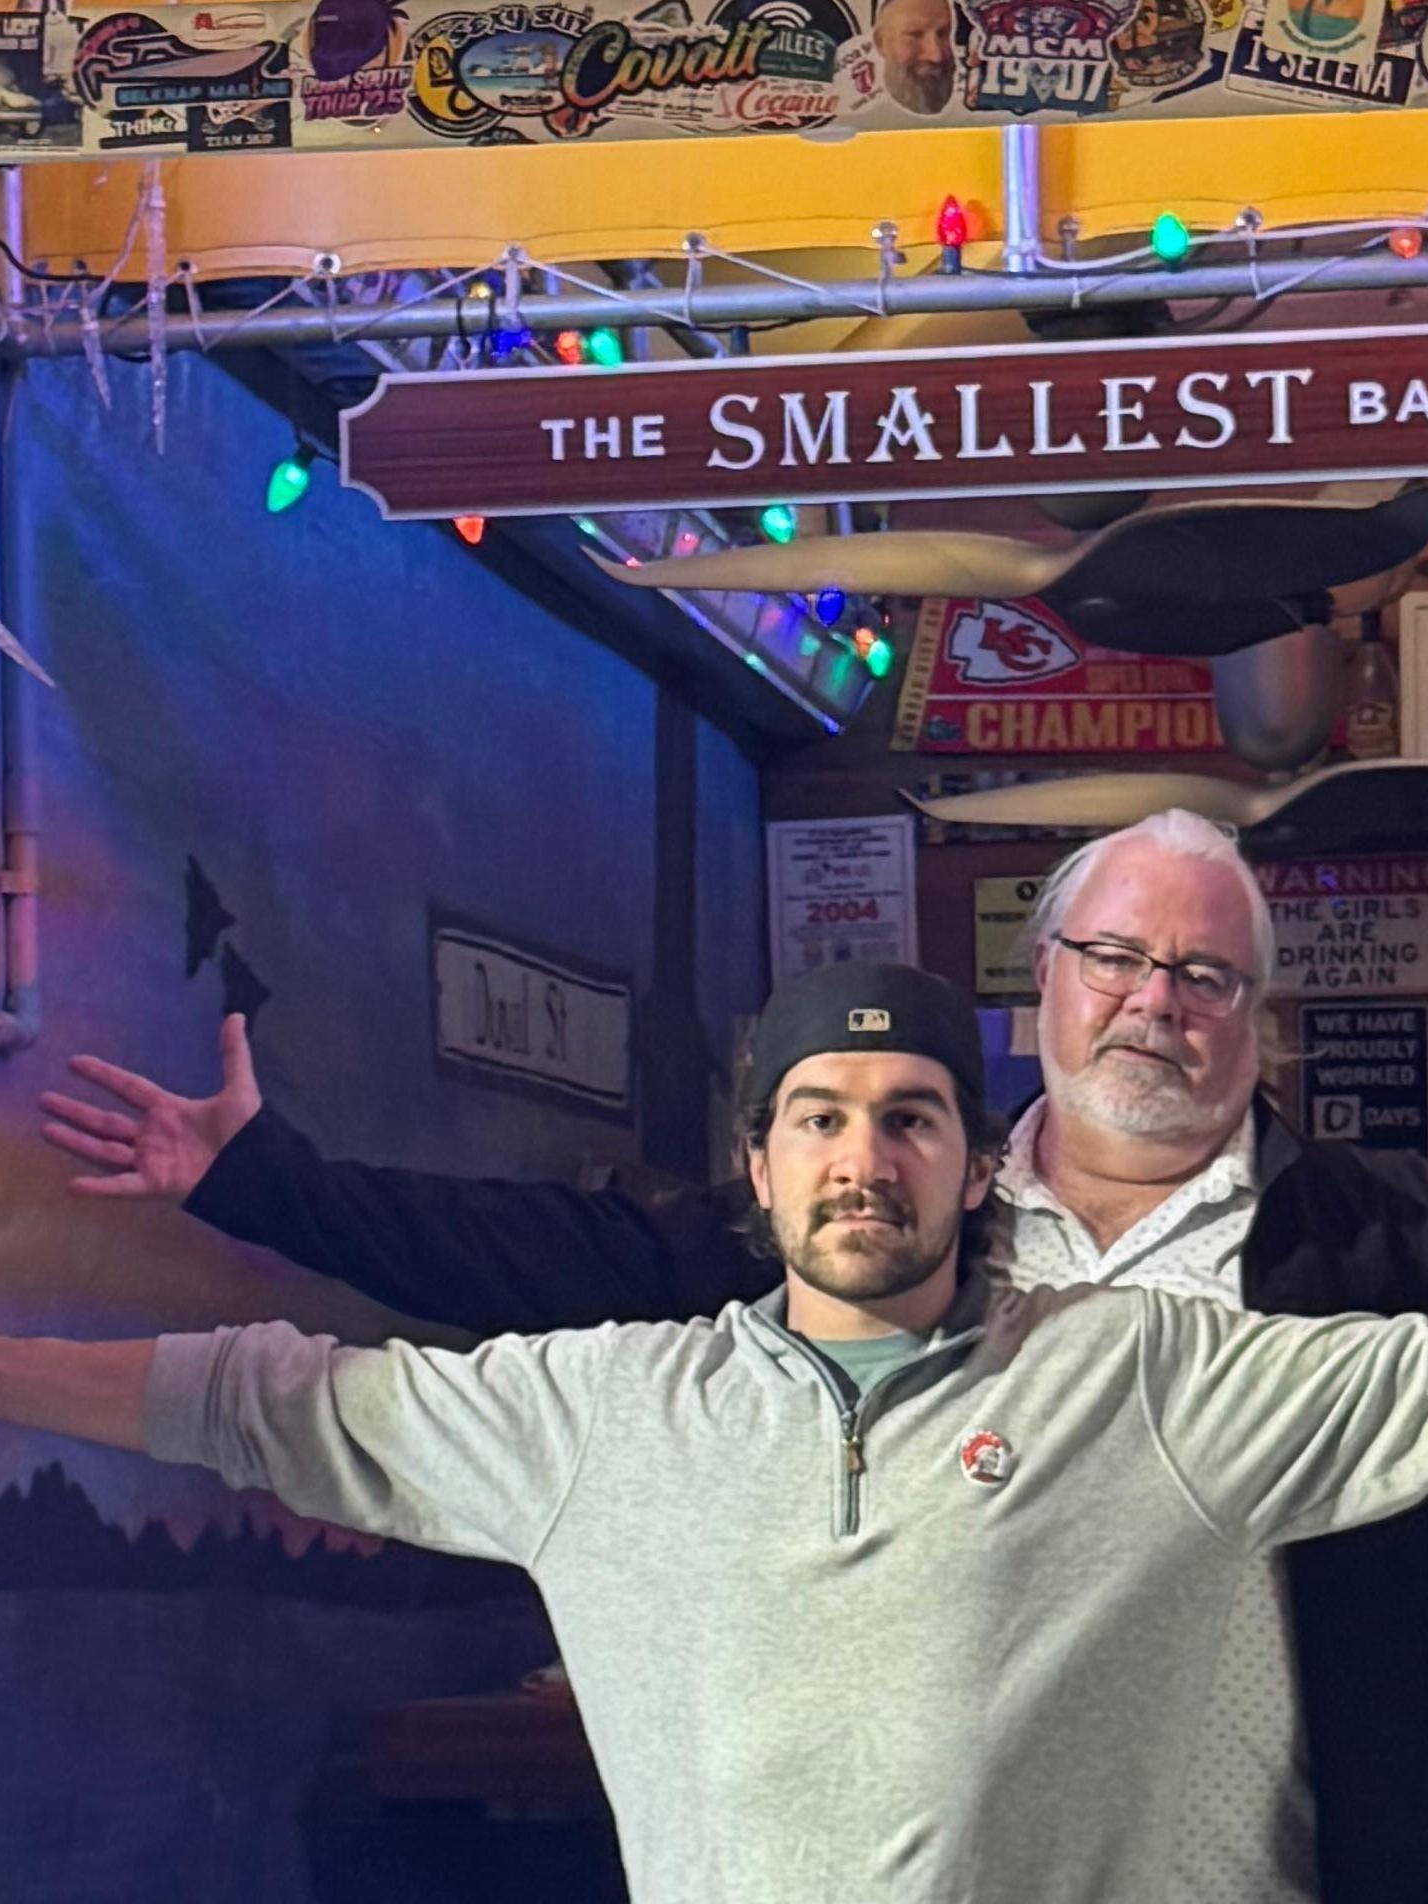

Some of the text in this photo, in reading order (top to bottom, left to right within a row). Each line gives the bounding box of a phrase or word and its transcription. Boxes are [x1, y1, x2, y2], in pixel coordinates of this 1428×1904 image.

[984, 36, 1105, 62] MCM
[559, 18, 772, 110] Covalt
[1280, 48, 1394, 100] SELENA
[541, 416, 667, 462] THE
[706, 367, 1314, 471] SMALLEST
[806, 900, 880, 924] 2004
[1269, 898, 1421, 922] THE GIRLS
[1317, 921, 1377, 943] ARE
[1278, 944, 1420, 968] DRINKING
[1303, 967, 1396, 989] AGAIN
[1314, 1012, 1417, 1033] WE HAVE
[1314, 1065, 1416, 1086] WORKED
